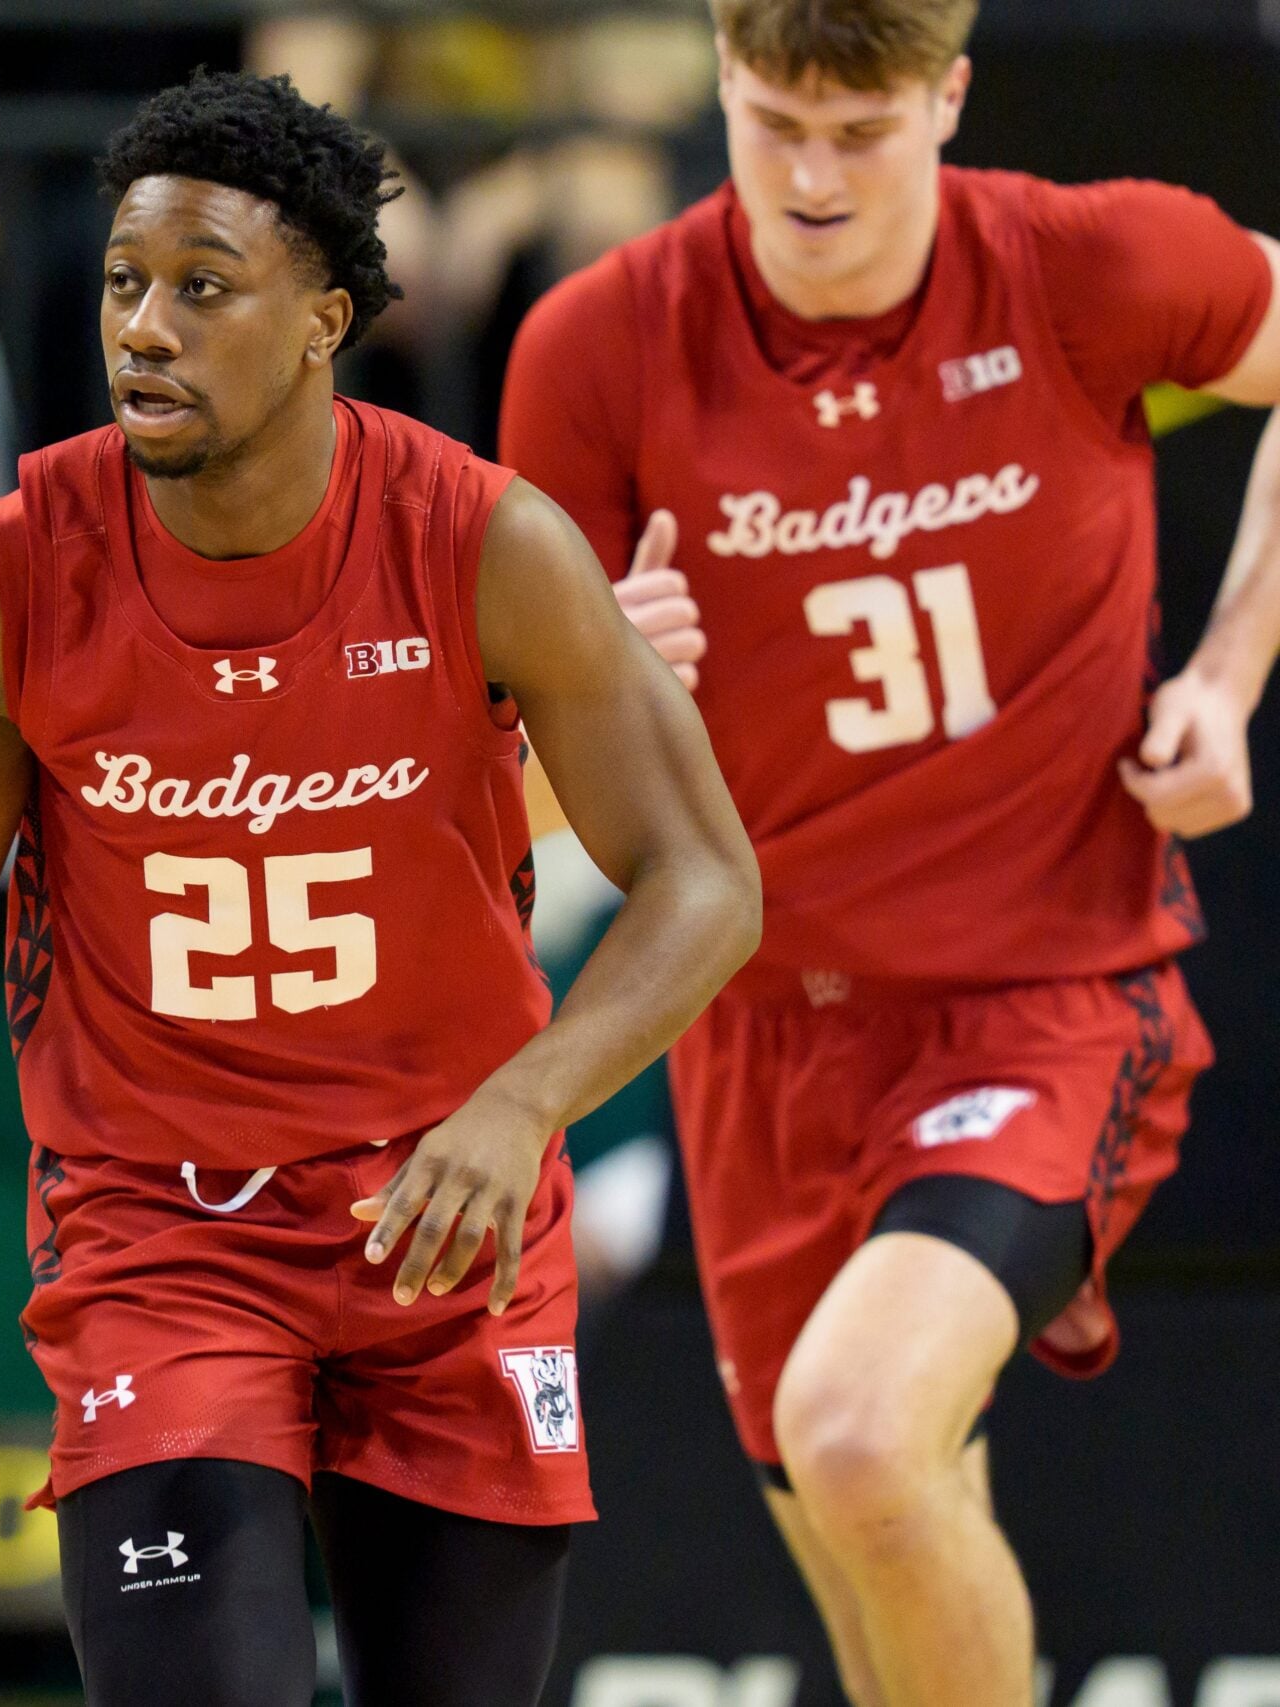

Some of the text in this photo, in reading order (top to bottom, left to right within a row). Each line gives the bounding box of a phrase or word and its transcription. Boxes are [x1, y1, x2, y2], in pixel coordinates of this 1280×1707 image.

[707, 463, 1039, 559] Badgers
[803, 562, 998, 754] 31
[81, 751, 429, 834] Badgers
[143, 846, 377, 1021] 25
[120, 1574, 201, 1592] UNDER ARMOUR
